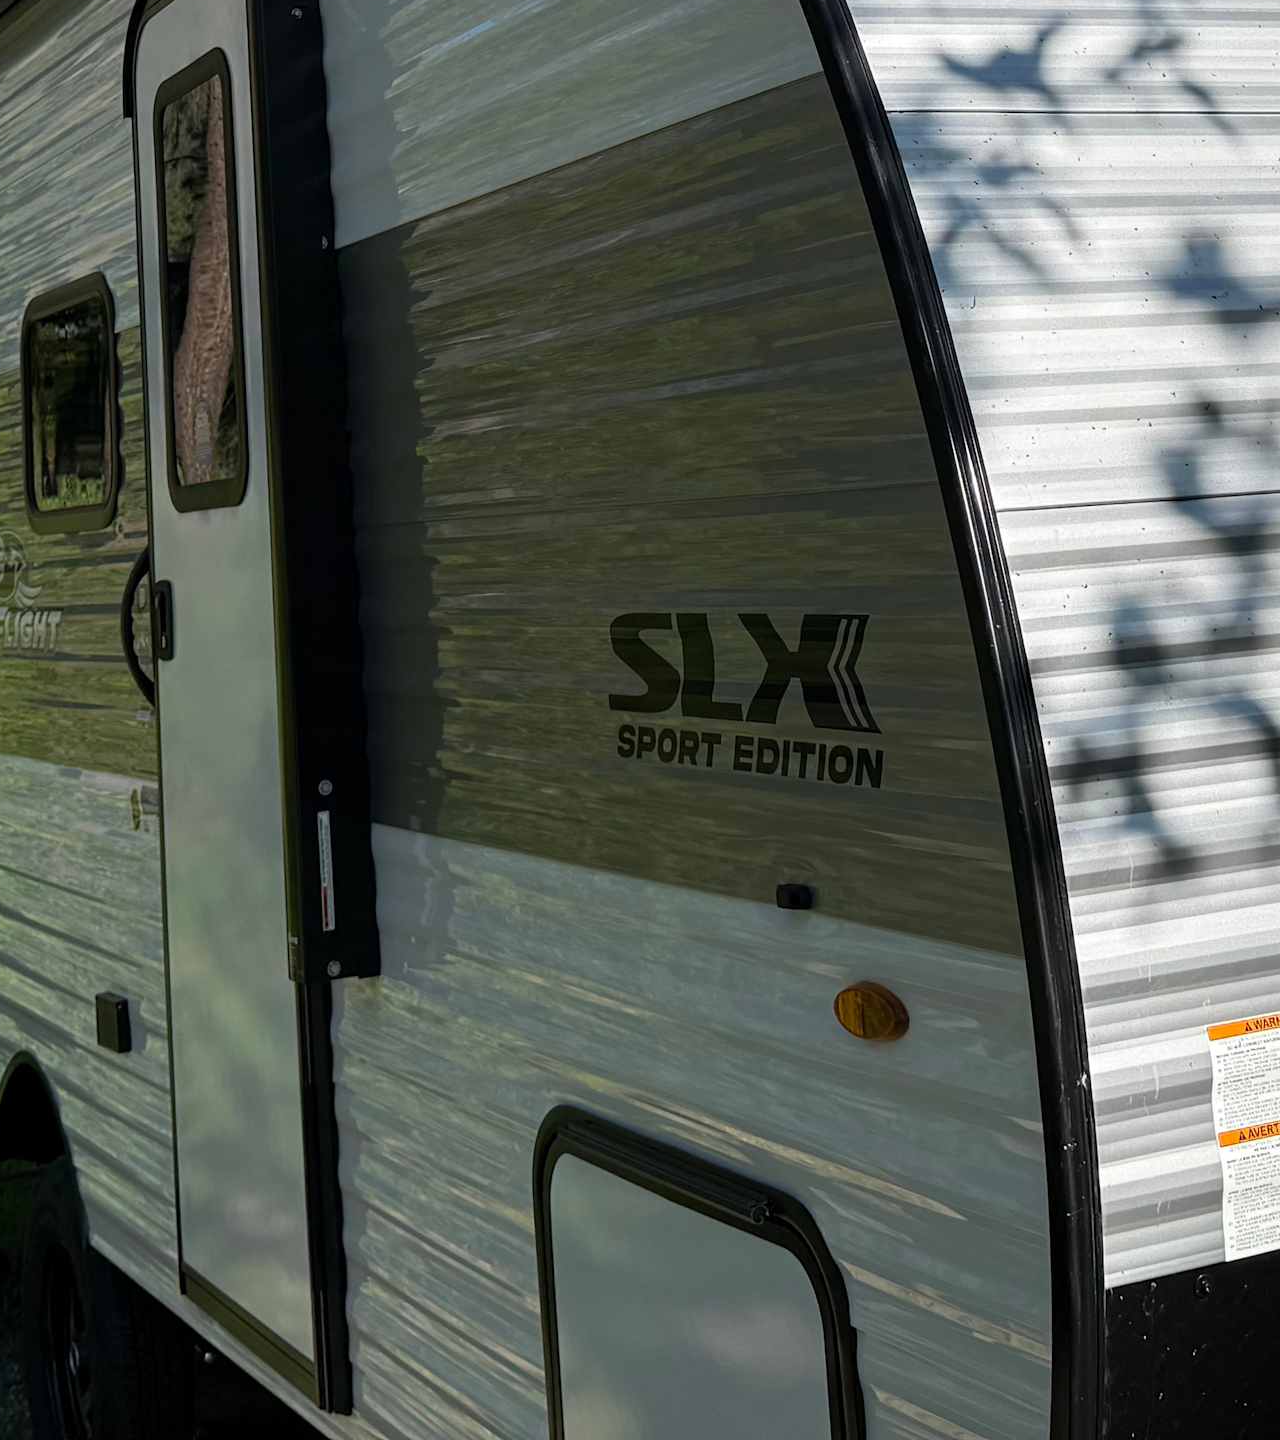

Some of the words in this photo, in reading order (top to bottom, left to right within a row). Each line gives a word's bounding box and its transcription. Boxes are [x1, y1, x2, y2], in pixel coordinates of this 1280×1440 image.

[608, 612, 882, 734] SLX
[617, 724, 722, 768] SPORT
[732, 734, 884, 789] EDITION
